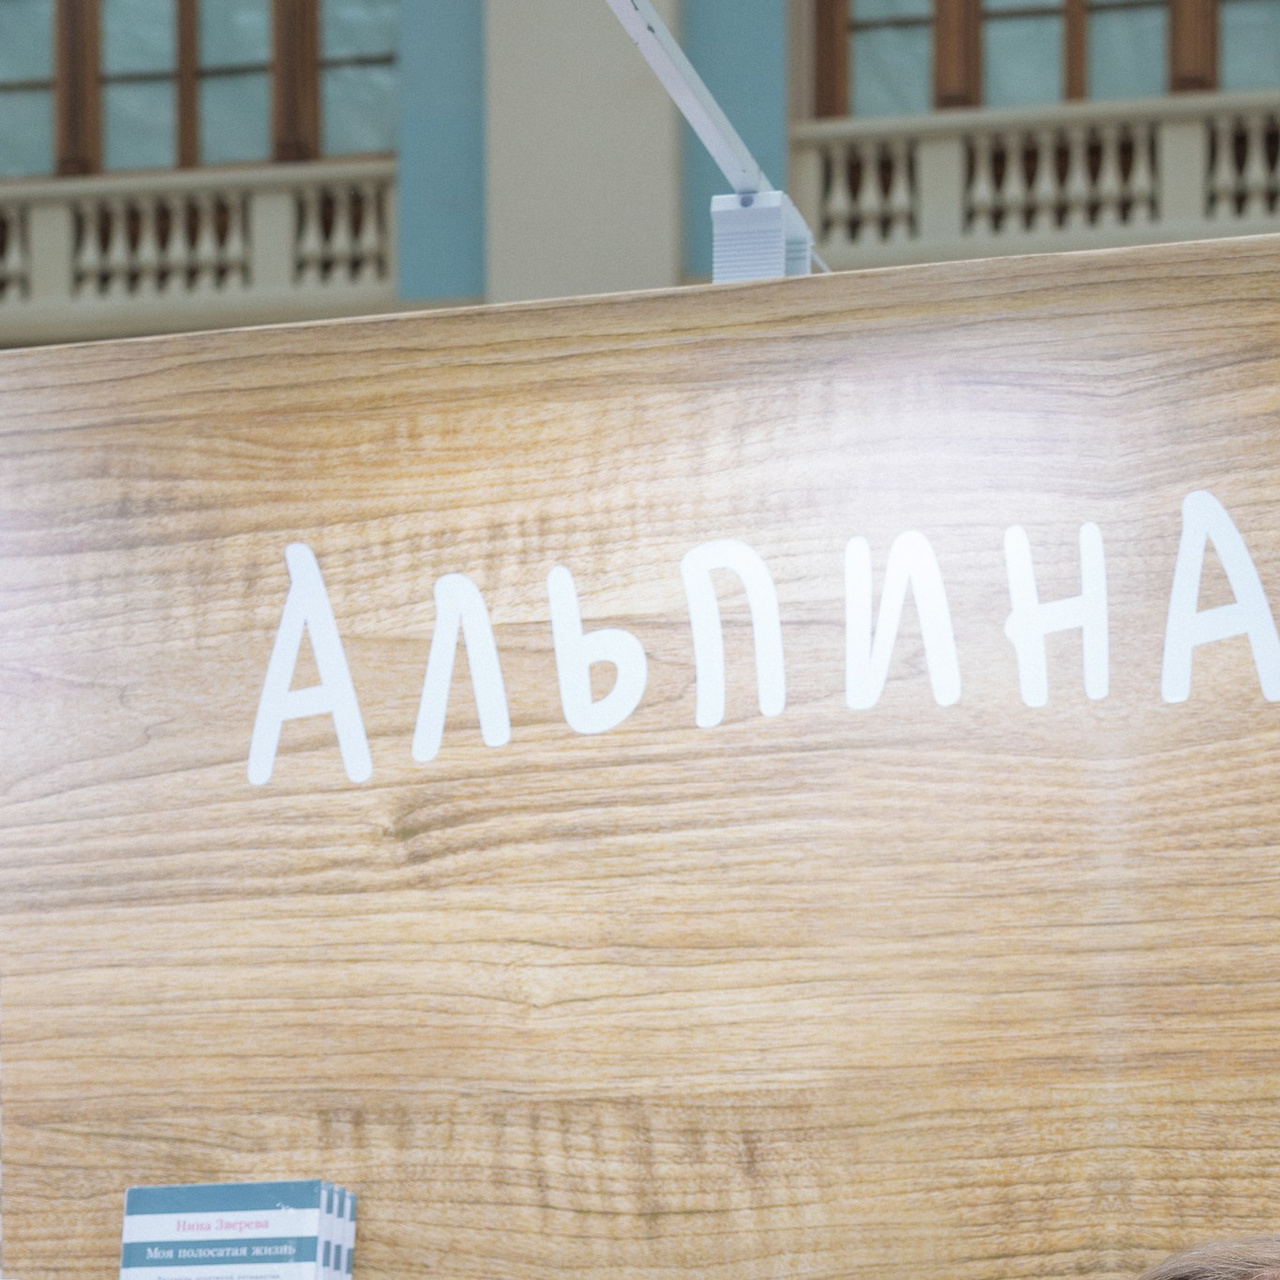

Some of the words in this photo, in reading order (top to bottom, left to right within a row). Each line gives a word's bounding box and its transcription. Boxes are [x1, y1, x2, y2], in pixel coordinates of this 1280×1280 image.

[176, 1220, 211, 1232] Нина
[215, 1219, 269, 1233] Зверева
[146, 1247, 174, 1260] Моя
[178, 1246, 248, 1259] полосатая
[252, 1244, 296, 1257] жизнь
